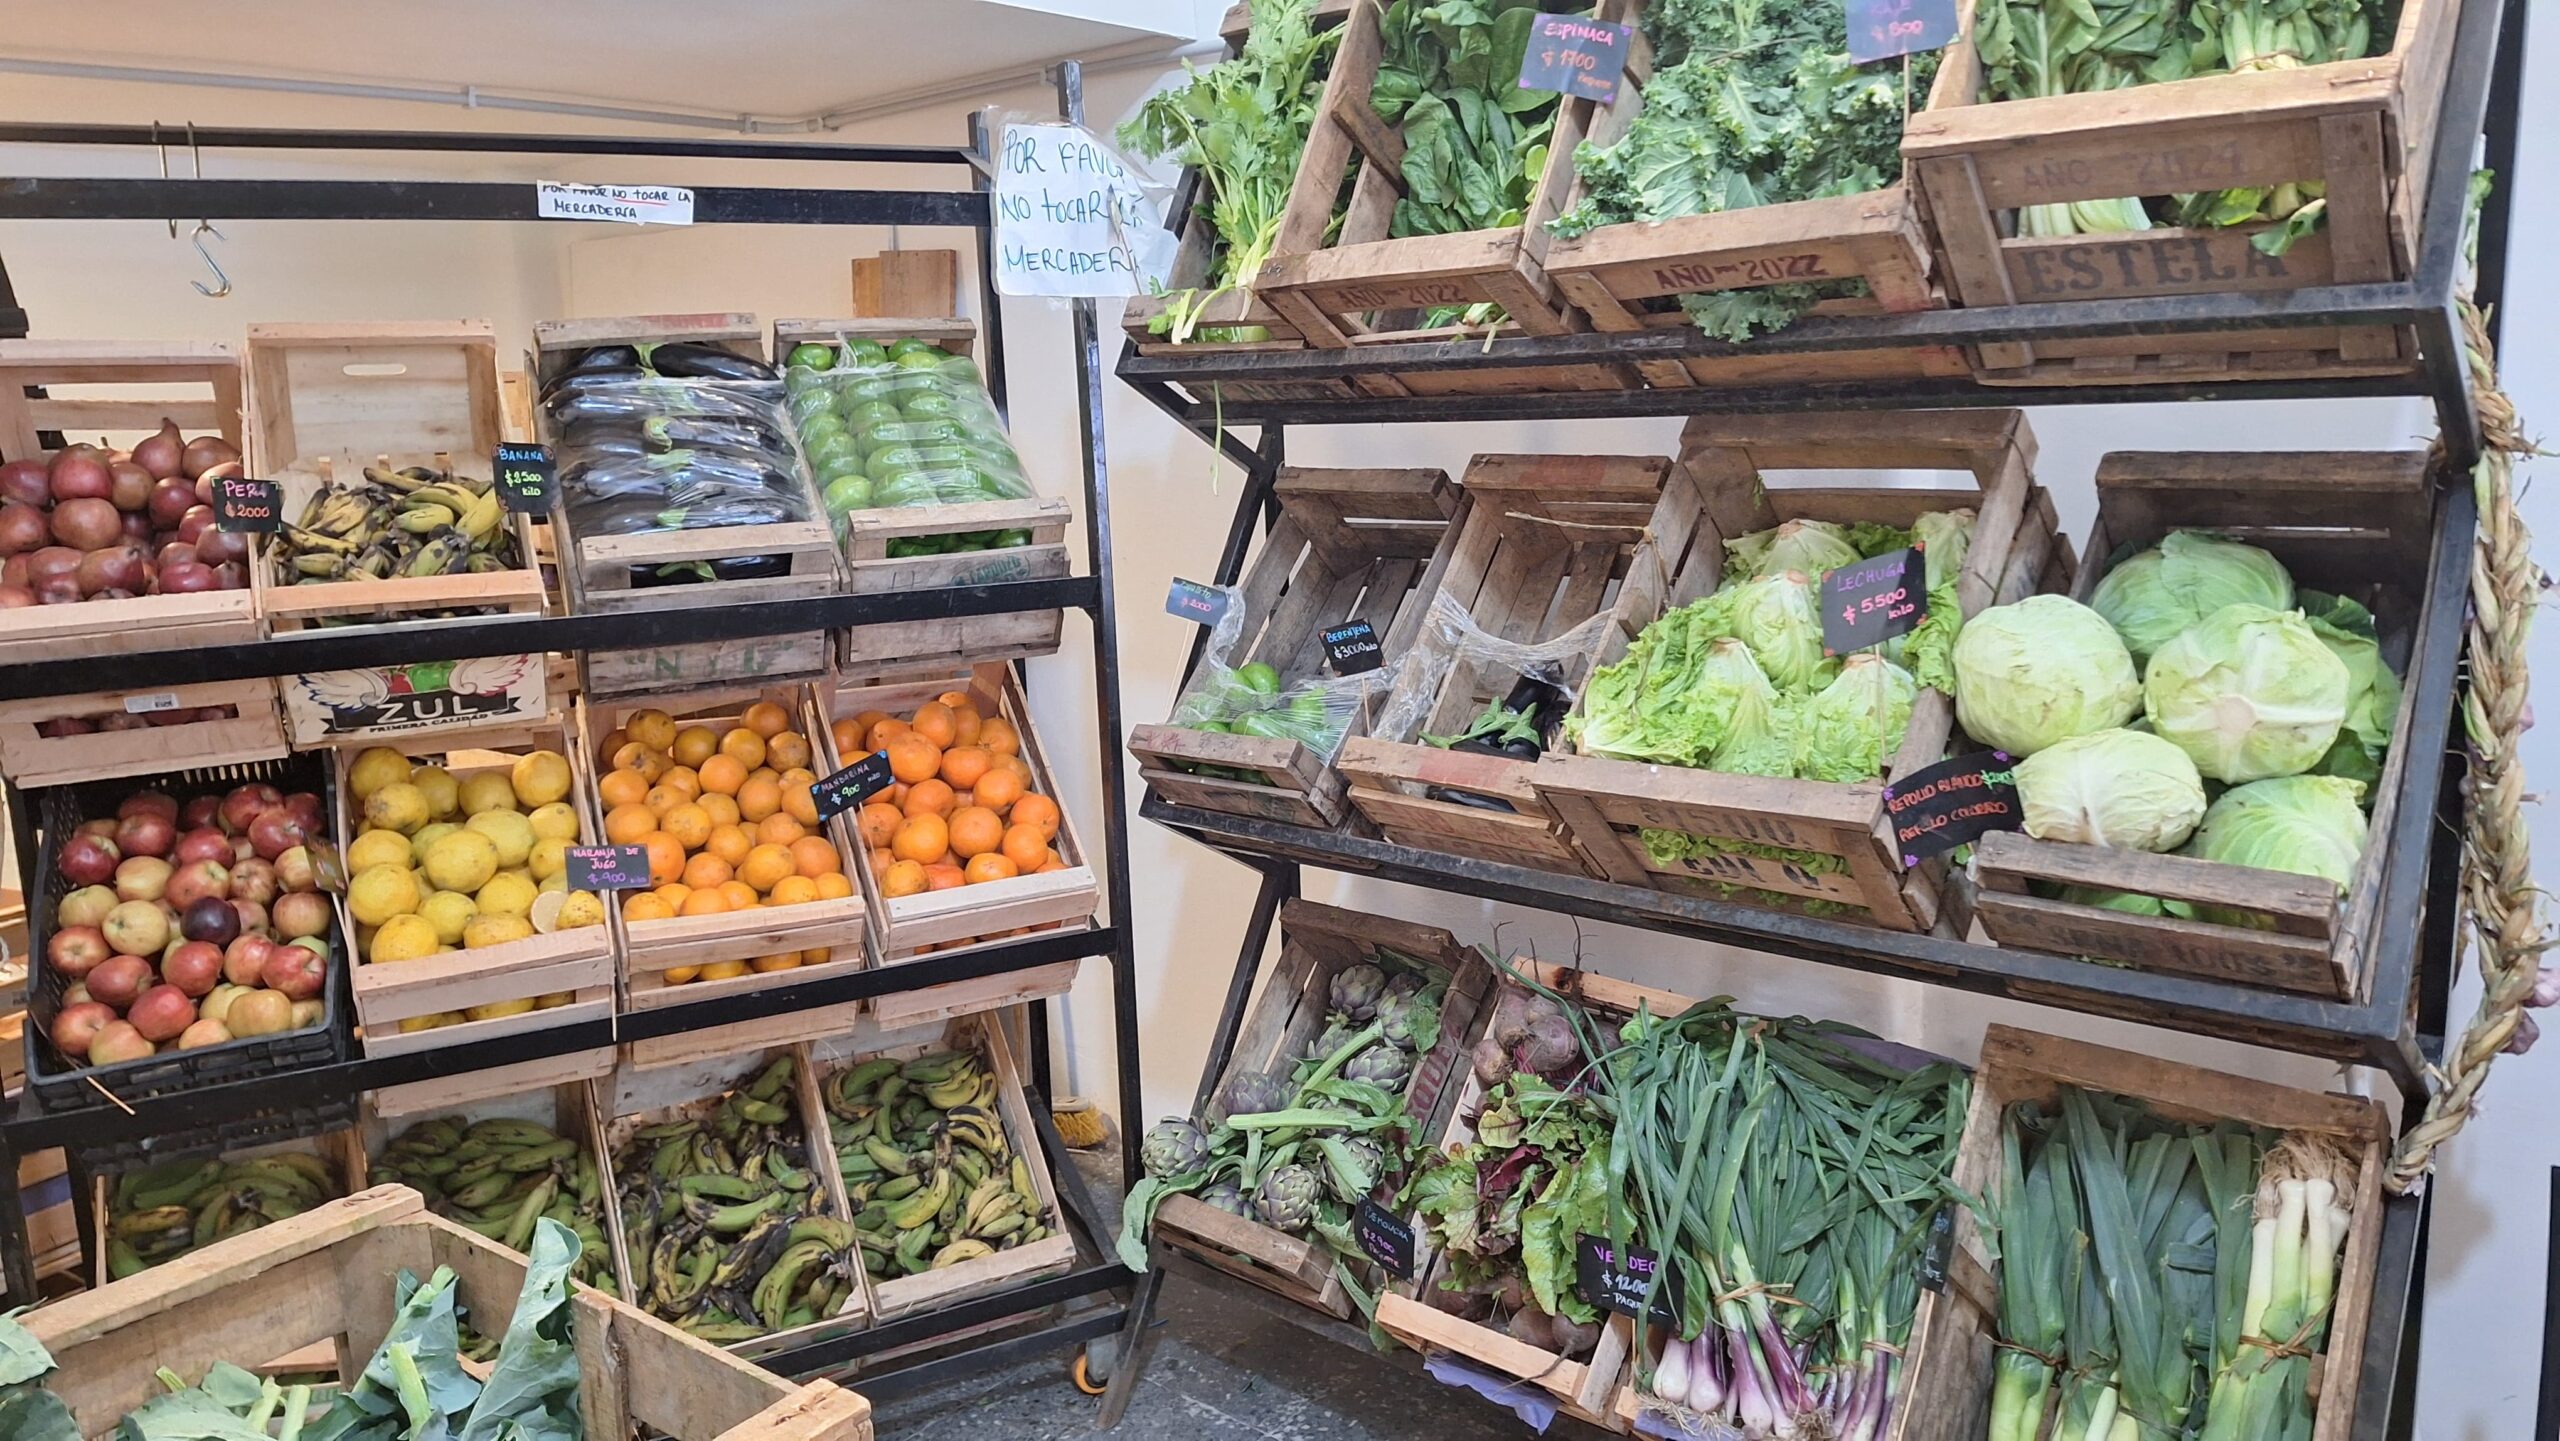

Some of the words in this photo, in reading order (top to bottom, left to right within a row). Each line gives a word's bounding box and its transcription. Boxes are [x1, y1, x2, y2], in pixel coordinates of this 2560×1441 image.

[1543, 22, 1614, 46] ESPINACA
[1006, 129, 1046, 174] POR
[612, 189, 627, 199] NO
[678, 191, 691, 203] LA
[1000, 192, 1031, 222] NO
[1004, 245, 1141, 277] MERCADER
[2018, 235, 2290, 295] ESTELA
[499, 448, 544, 463] BANANA
[222, 480, 268, 498] PERA
[1836, 561, 1906, 593] LECHUGA
[1326, 624, 1371, 644] BERENJENA
[369, 721, 428, 733] PRIMERA
[431, 713, 488, 727] CALIDAD
[376, 695, 479, 725] ZUL
[821, 763, 870, 793] MANDARINA
[1898, 814, 1948, 842] REPLO
[572, 848, 616, 859] NARANJA
[625, 847, 639, 856] DE
[589, 857, 616, 870] JUGO
